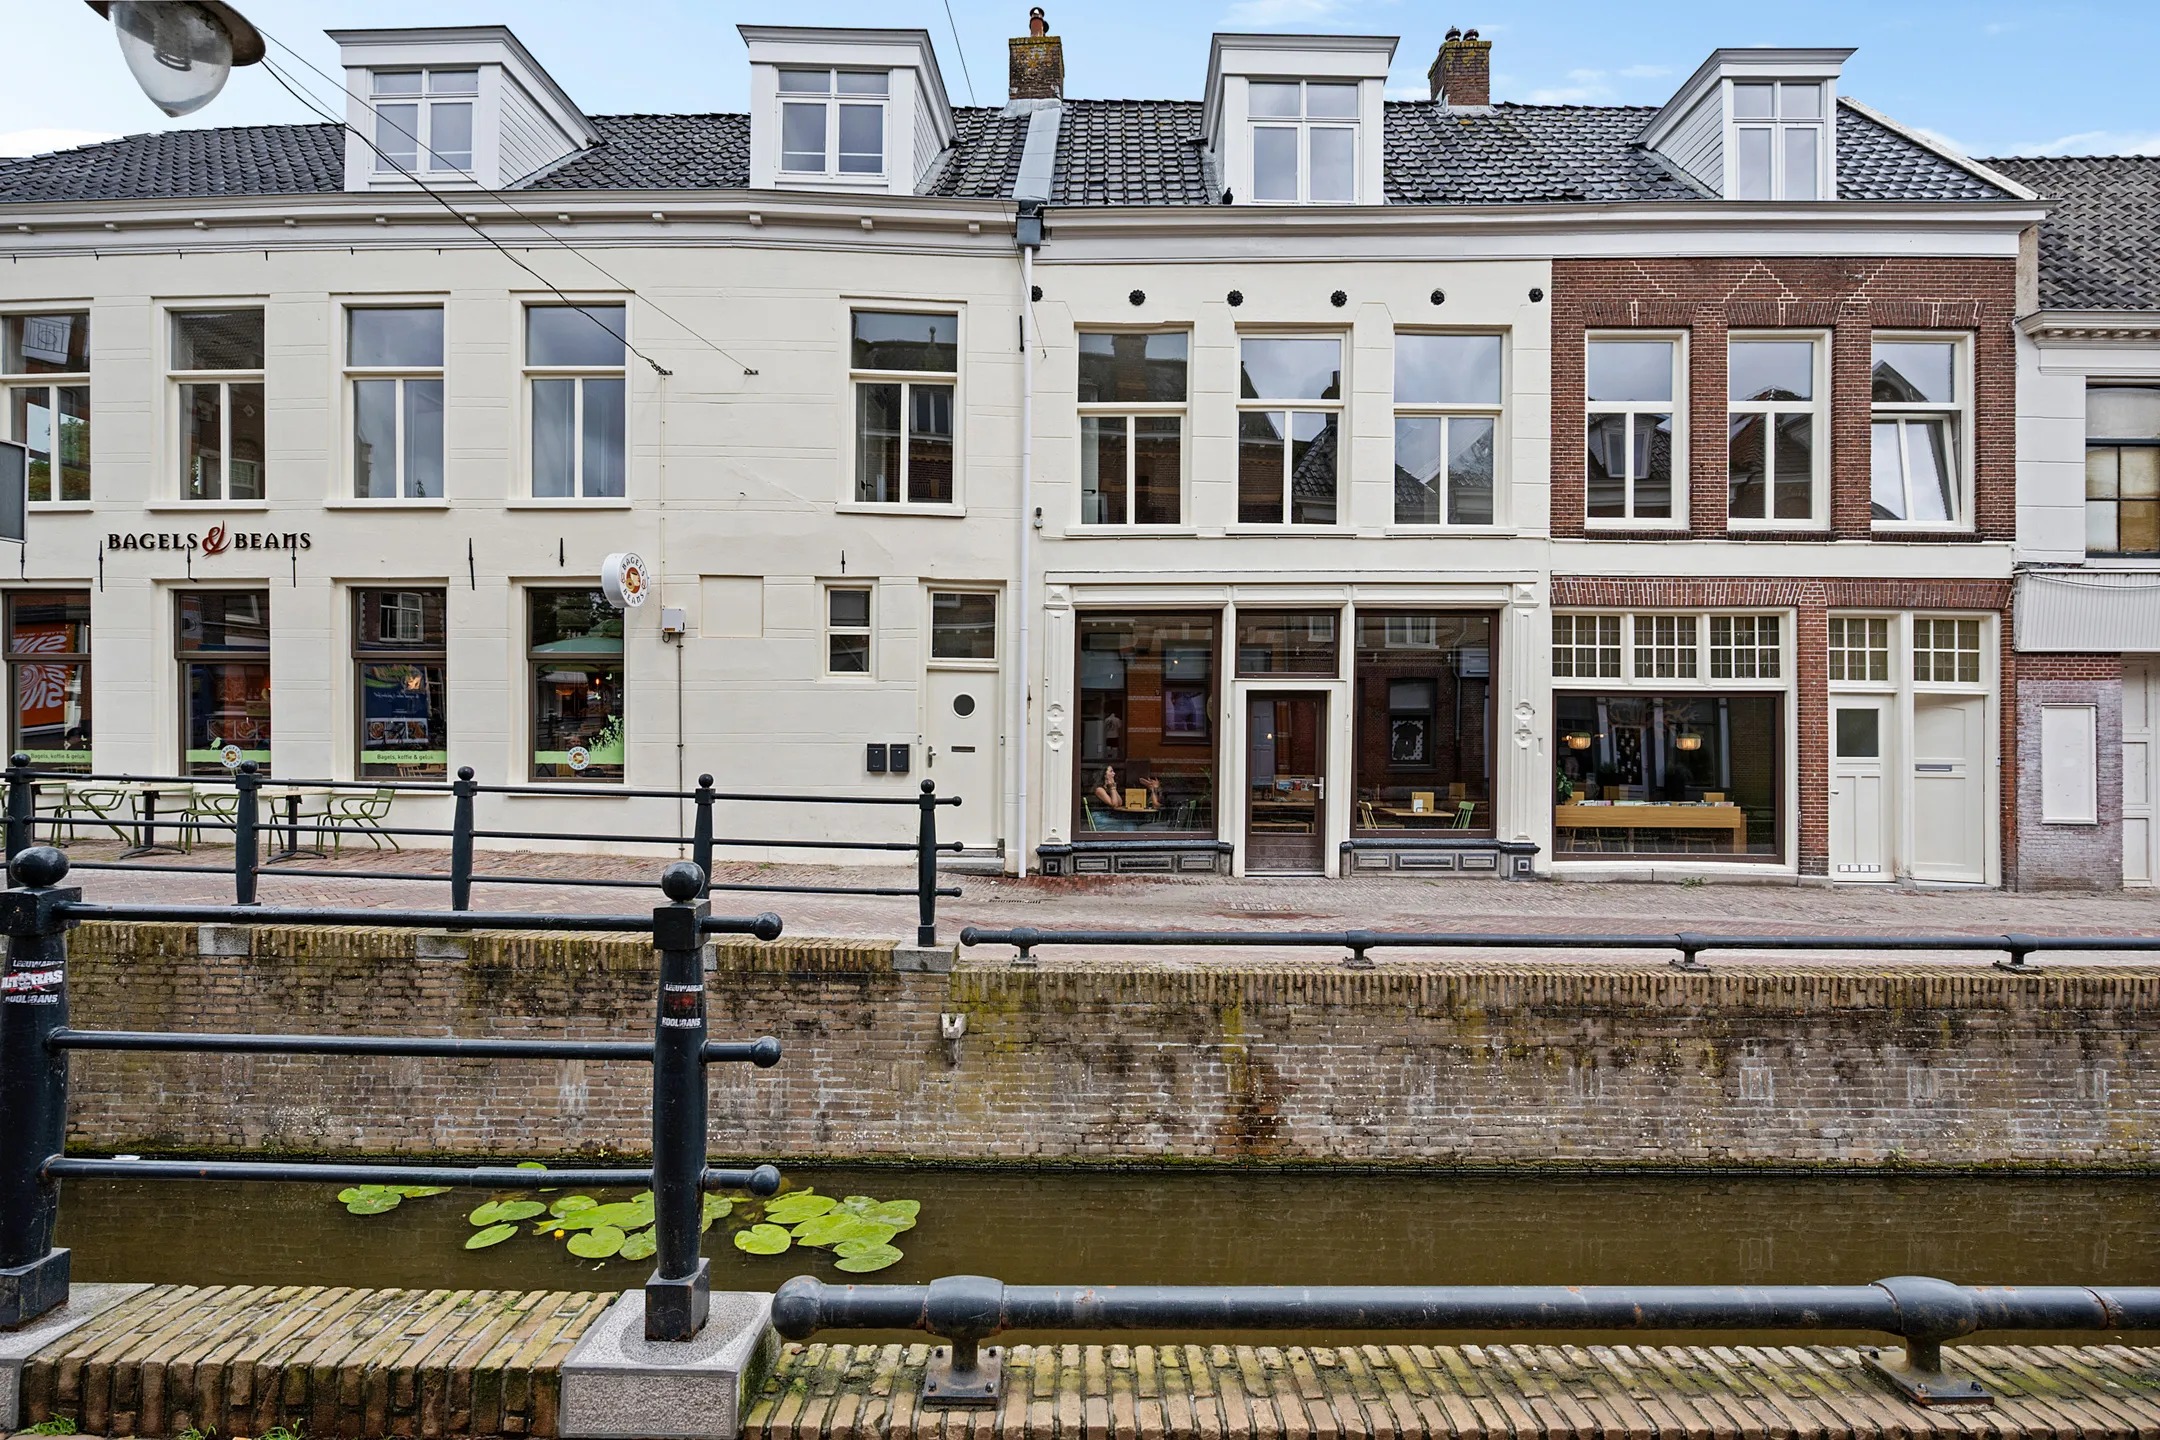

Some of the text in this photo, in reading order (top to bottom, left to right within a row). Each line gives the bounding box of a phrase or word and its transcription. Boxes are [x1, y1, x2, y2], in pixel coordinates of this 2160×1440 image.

[107, 519, 311, 558] BAGELS & BEANS
[621, 556, 645, 577] BAGELS
[623, 588, 644, 605] BEANS
